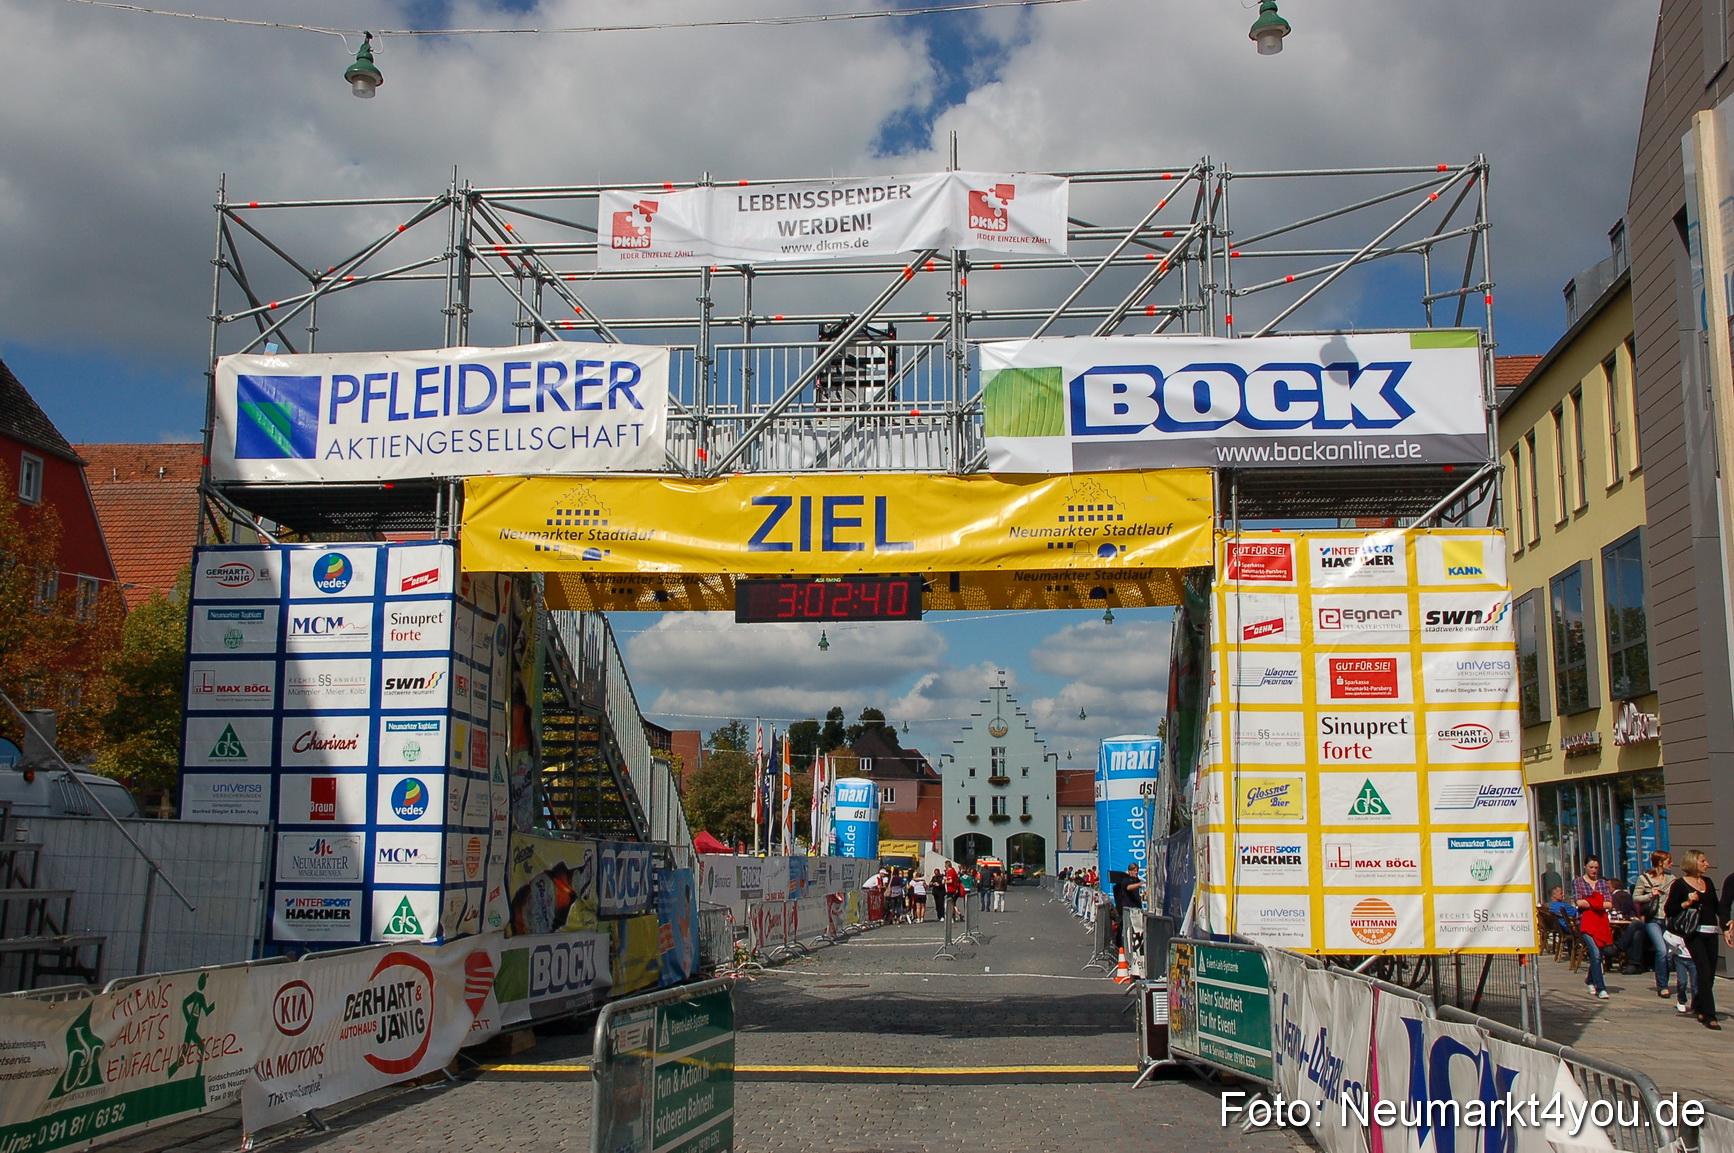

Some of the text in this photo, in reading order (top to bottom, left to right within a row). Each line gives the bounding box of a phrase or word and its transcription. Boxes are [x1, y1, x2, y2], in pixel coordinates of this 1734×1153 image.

[738, 184, 911, 213] LEBENSSPENDER
[777, 214, 872, 236] WERDEN!
[971, 216, 1006, 229] DKMS
[614, 235, 649, 247] DKMS
[781, 238, 869, 253] www.dkms.de
[977, 233, 995, 241] JEDER
[1032, 236, 1051, 244] ZÄHLT
[329, 360, 644, 425] PFLEIDERER
[1070, 361, 1416, 435] BOCK
[325, 423, 644, 461] AKTIENGESELLSCHAFT
[1217, 439, 1422, 463] www.bockonline.de
[747, 495, 915, 552] ZIEL
[1009, 522, 1173, 538] Neumarkter Stadtlauf
[499, 528, 655, 541] Neumarkter Stadtlauf
[1251, 546, 1267, 554] FÜR
[1270, 547, 1285, 555] SIE!
[1014, 570, 1154, 581] Neumarkter Stadtlauf
[1448, 567, 1482, 576] KANN
[317, 579, 347, 589] vedes
[778, 582, 909, 617] 3:02:40
[391, 612, 443, 627] Sinupret
[1343, 609, 1402, 622] Egner
[1426, 610, 1483, 625] swn
[293, 617, 343, 633] MCM
[391, 629, 421, 641] forte
[1265, 668, 1297, 676] Wagner
[1336, 661, 1391, 670] GUT FÜR SIE!
[1457, 661, 1510, 670] uniVersa
[244, 684, 271, 692] BÖGL
[385, 678, 425, 689] swn
[1322, 717, 1408, 739] Sinupret
[292, 731, 359, 753] Charivari
[1323, 741, 1372, 759] forte
[1111, 746, 1156, 771] maxi
[838, 787, 868, 803] maxi
[1247, 784, 1290, 807] Glossner
[1479, 785, 1521, 797] Wagner
[1271, 797, 1290, 807] Bier
[396, 805, 423, 815] vedes
[854, 809, 867, 819] dsl
[293, 856, 348, 869] NEUMARKTER
[379, 848, 418, 862] MCM
[1242, 856, 1301, 864] HACKNER
[1386, 858, 1416, 867] BÖGL
[296, 898, 351, 906] INTERSPORT
[286, 909, 350, 919] HACKNER
[1260, 909, 1304, 917] uniVersa
[1356, 932, 1392, 945] VERPACKUNG
[529, 939, 596, 998] BOCK
[344, 981, 422, 1022] GERHART &
[1199, 988, 1243, 1013] Mehr Sicherheit
[280, 993, 307, 1025] KIA
[339, 1008, 425, 1044] AUTOHAUS JÄNIG
[1199, 1010, 1236, 1035] für Ihr Event!
[277, 1043, 325, 1077] MOTORS
[657, 1075, 671, 1100] Fun
[673, 1069, 679, 1093] &
[680, 1062, 701, 1090] Action
[656, 1087, 714, 1137] sicheren Bahnen!
[49, 1119, 66, 1141] 91
[70, 1115, 86, 1136] 81
[96, 1107, 110, 1128] 63
[111, 1102, 126, 1121] 52
